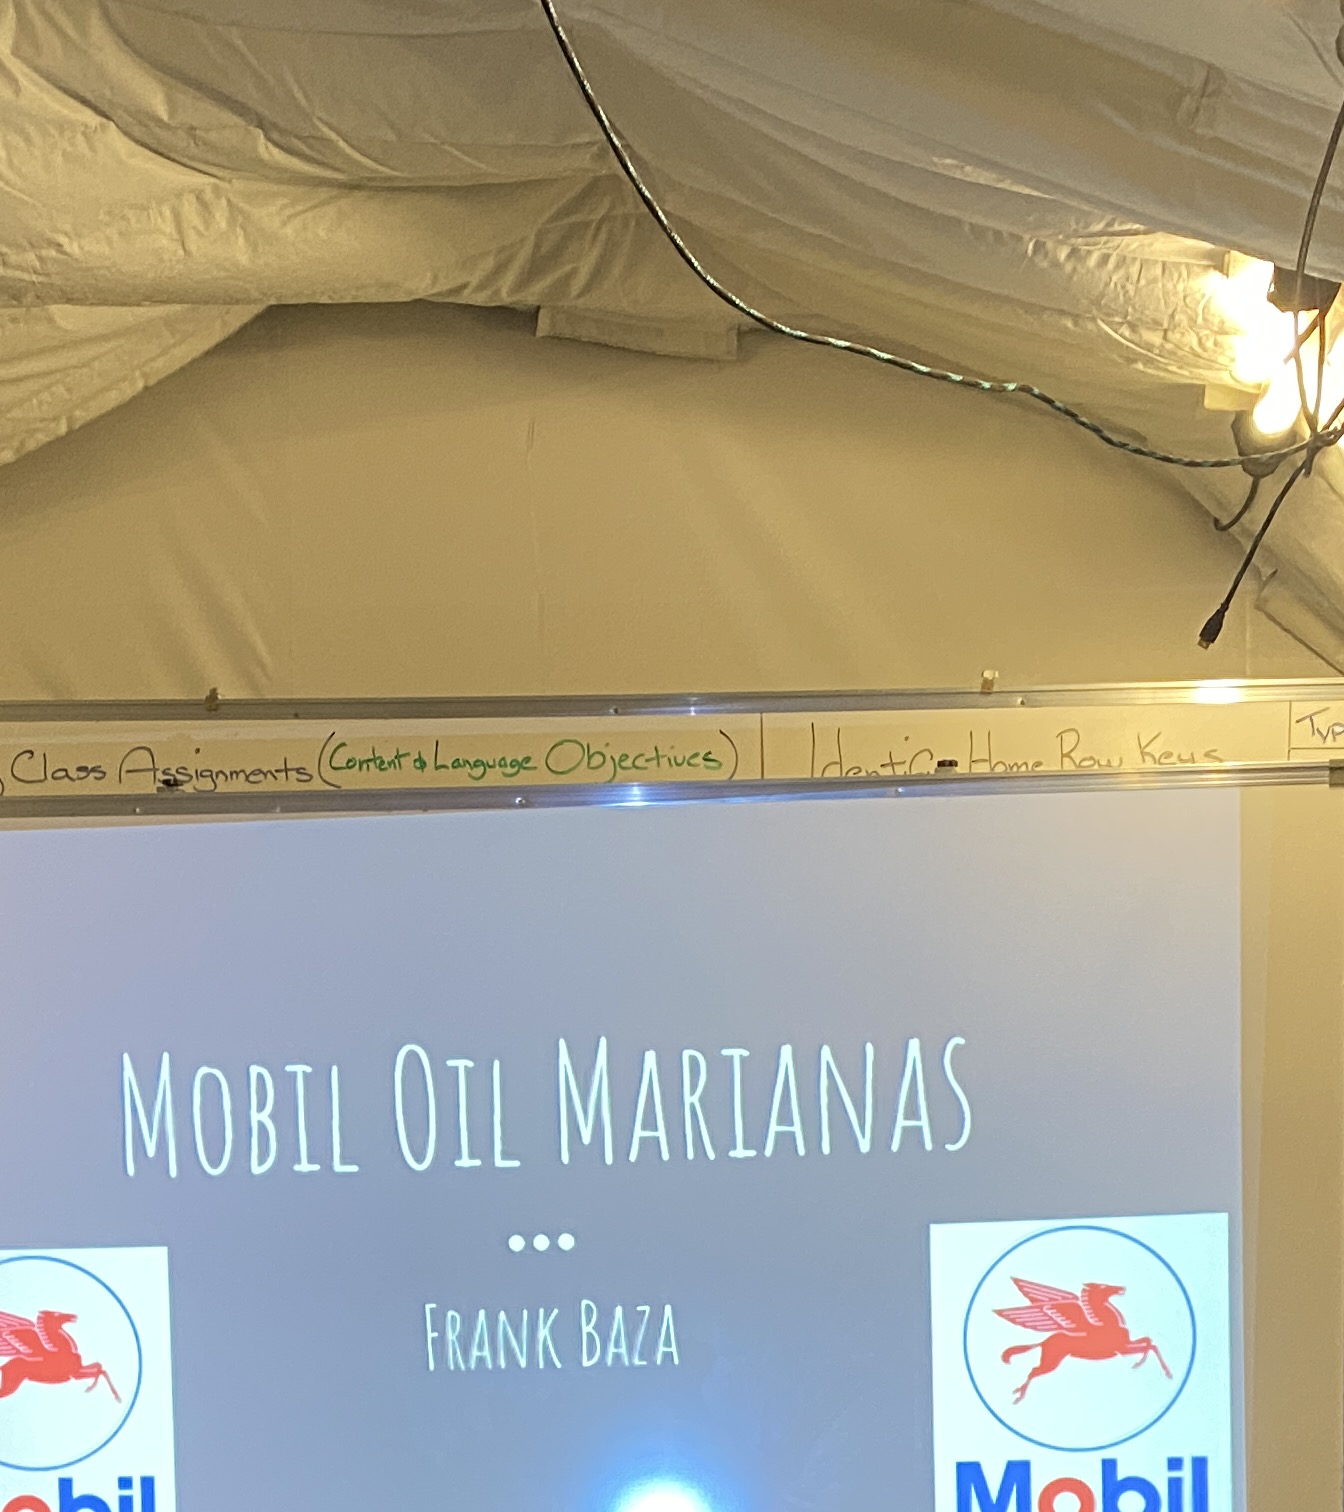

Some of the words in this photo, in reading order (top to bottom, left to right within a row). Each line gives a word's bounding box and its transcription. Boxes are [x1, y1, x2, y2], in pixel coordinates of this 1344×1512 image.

[11, 749, 106, 784] Class
[119, 746, 313, 792] Assignments
[435, 739, 537, 780] Language
